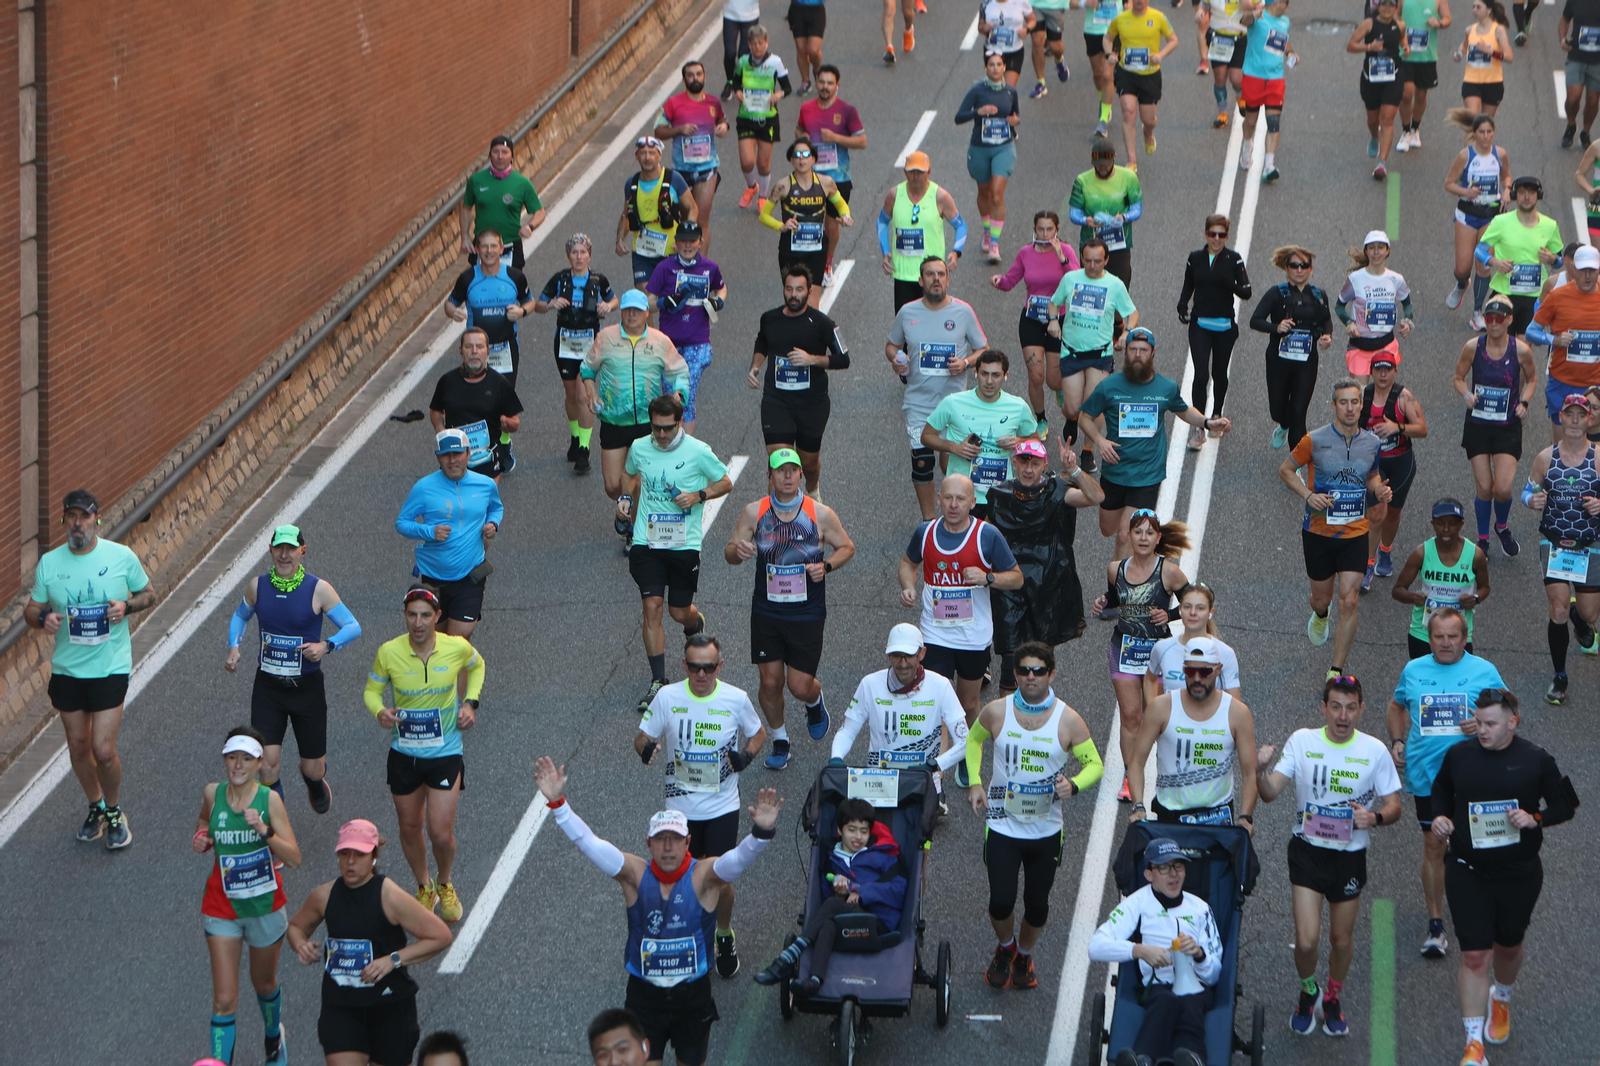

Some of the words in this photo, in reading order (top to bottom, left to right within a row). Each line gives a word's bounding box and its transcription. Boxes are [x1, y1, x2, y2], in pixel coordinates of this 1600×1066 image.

[790, 196, 823, 206] X-SOLID
[647, 232, 664, 240] ZURICH
[933, 572, 966, 585] ITALI
[1424, 570, 1470, 583] MEENA
[943, 591, 967, 599] ZURICH
[80, 608, 104, 616] ZURICH
[273, 638, 296, 646] ZURICH
[1436, 695, 1461, 703] ZURICH
[409, 711, 434, 719] ZURICH
[900, 714, 926, 722] CARROS
[695, 722, 722, 731] CARROS
[694, 738, 717, 747] FUEGO
[1194, 743, 1224, 751] CARROS
[687, 752, 713, 761] ZURICH
[1021, 748, 1050, 759] CARROS
[1193, 758, 1217, 766] FUEGO
[1020, 764, 1044, 773] FUEGO
[1330, 769, 1359, 780] CARROS
[1329, 784, 1353, 795] FUEGO
[1320, 808, 1348, 818] ZURICH
[214, 829, 262, 845] PORTUGA
[1315, 830, 1338, 839] ALBERTO
[238, 852, 265, 865] ZURICH
[660, 942, 689, 951] ZURICH
[658, 958, 680, 967] 12107
[663, 966, 693, 974] GONZALEZ
